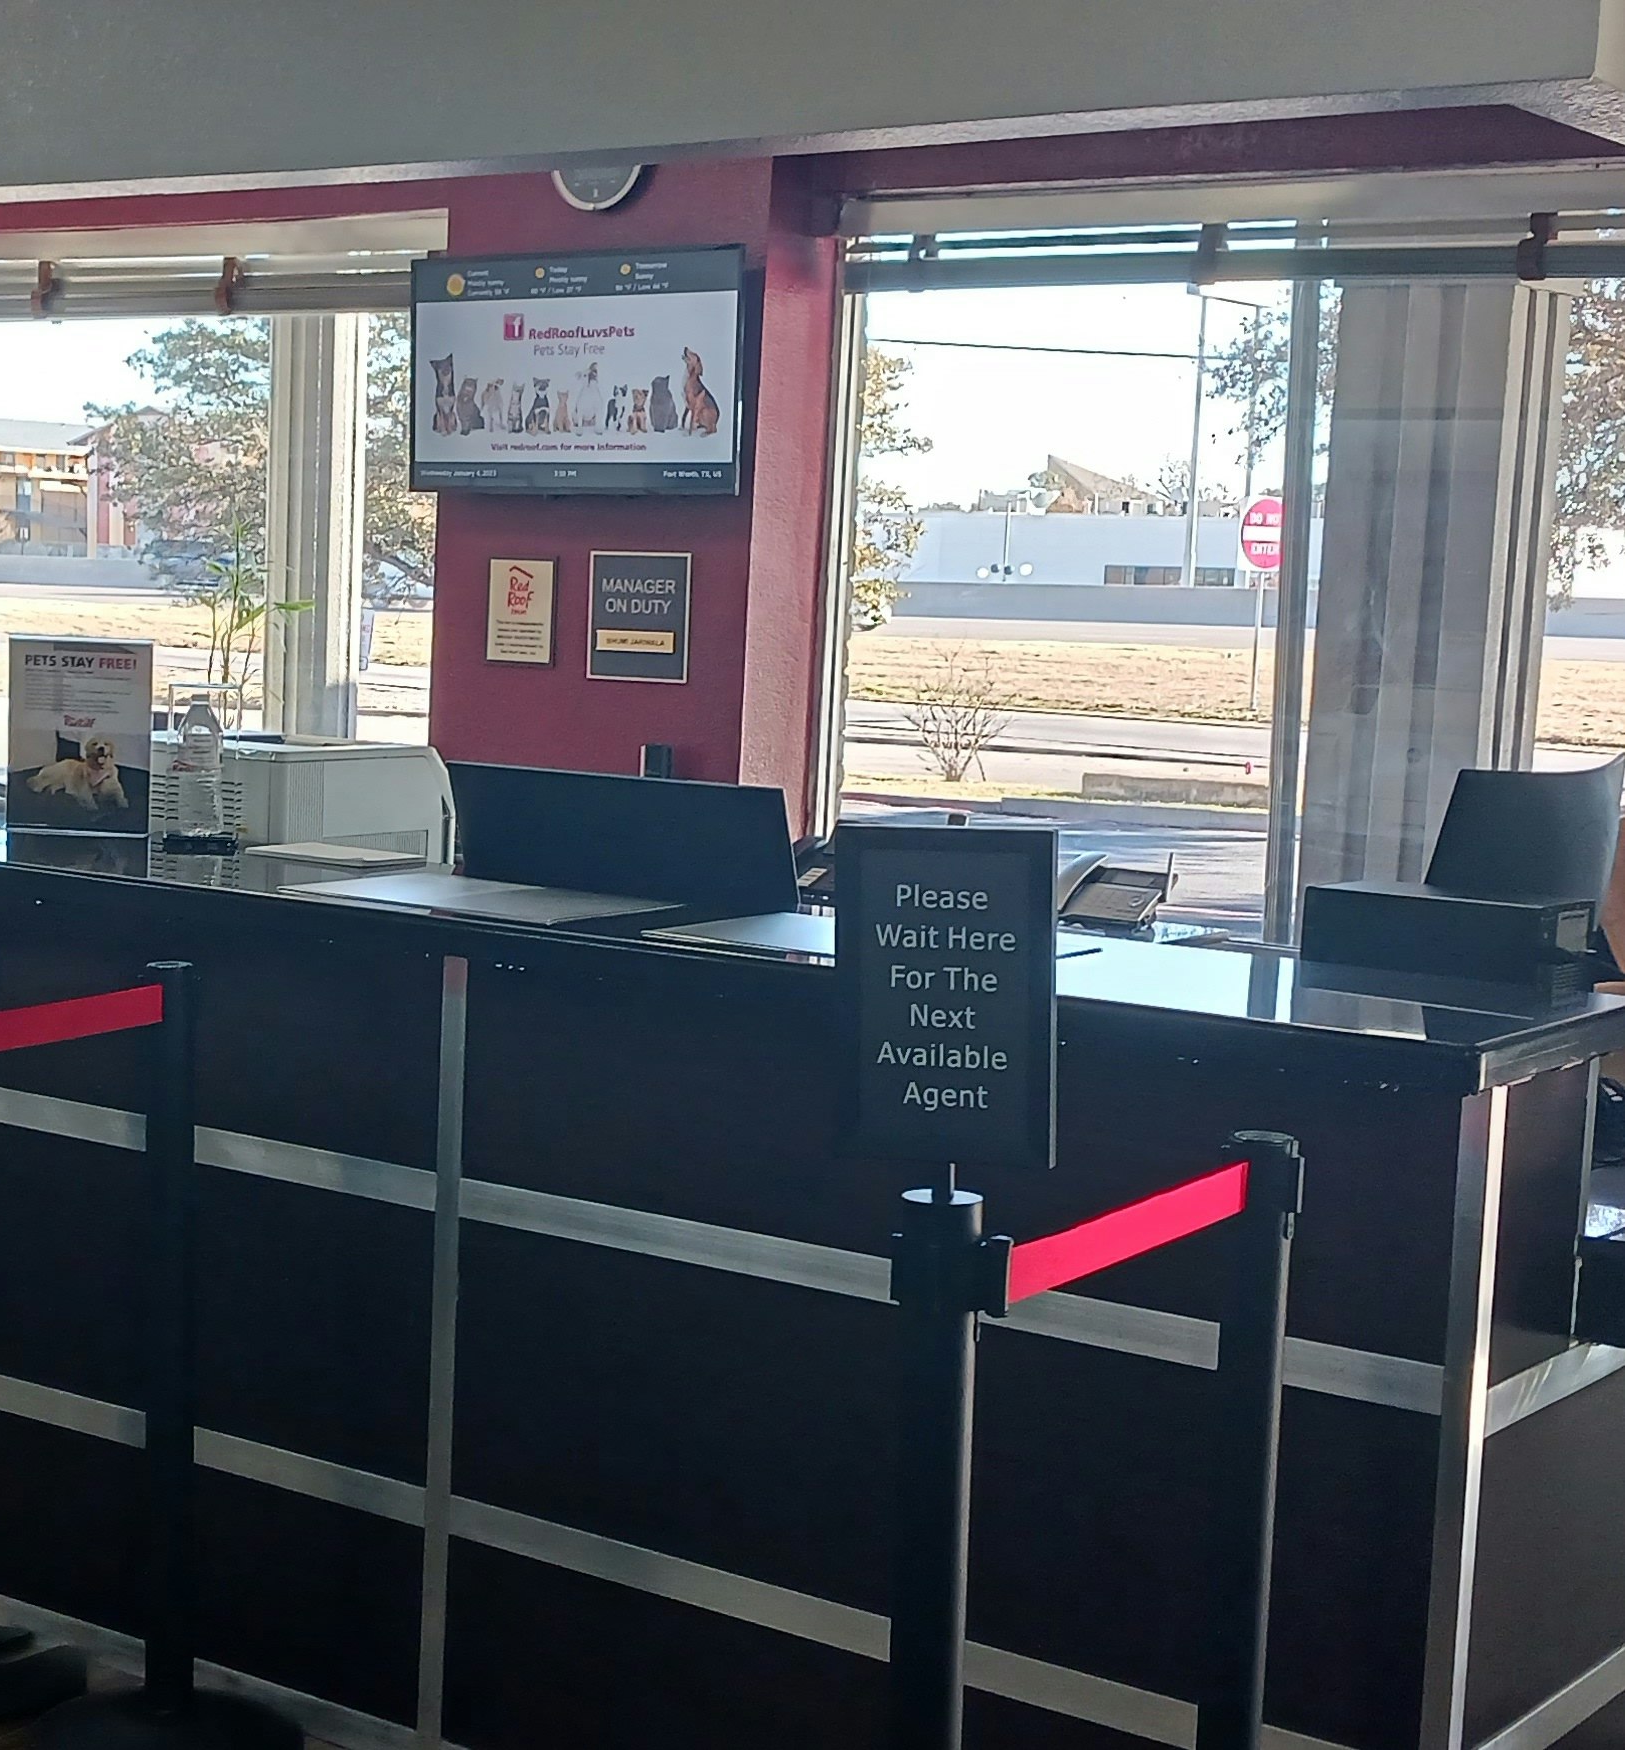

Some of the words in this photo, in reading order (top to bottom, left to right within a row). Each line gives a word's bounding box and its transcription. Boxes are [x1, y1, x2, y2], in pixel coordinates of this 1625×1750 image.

[528, 325, 635, 340] RedRoofLuvsPets
[533, 344, 555, 356] Pets
[557, 342, 580, 358] Stay
[583, 342, 605, 355] Free
[559, 442, 572, 451] for
[573, 443, 595, 451] more
[1249, 512, 1263, 525] DO
[1265, 512, 1281, 525] NO
[509, 576, 530, 592] Red
[601, 577, 676, 595] MANAGER
[507, 591, 535, 609] Roof
[605, 597, 627, 613] ON
[630, 598, 672, 615] DUTY
[24, 654, 57, 667] PETS
[61, 656, 95, 668] STAY
[98, 657, 137, 670] FREE!
[895, 884, 989, 910] Please
[875, 924, 939, 949] Wait
[948, 926, 1017, 951] Here
[890, 964, 935, 990] For
[942, 966, 998, 992] The
[909, 1004, 976, 1030] Next
[876, 1041, 1009, 1070] Available
[902, 1081, 989, 1111] Agent
